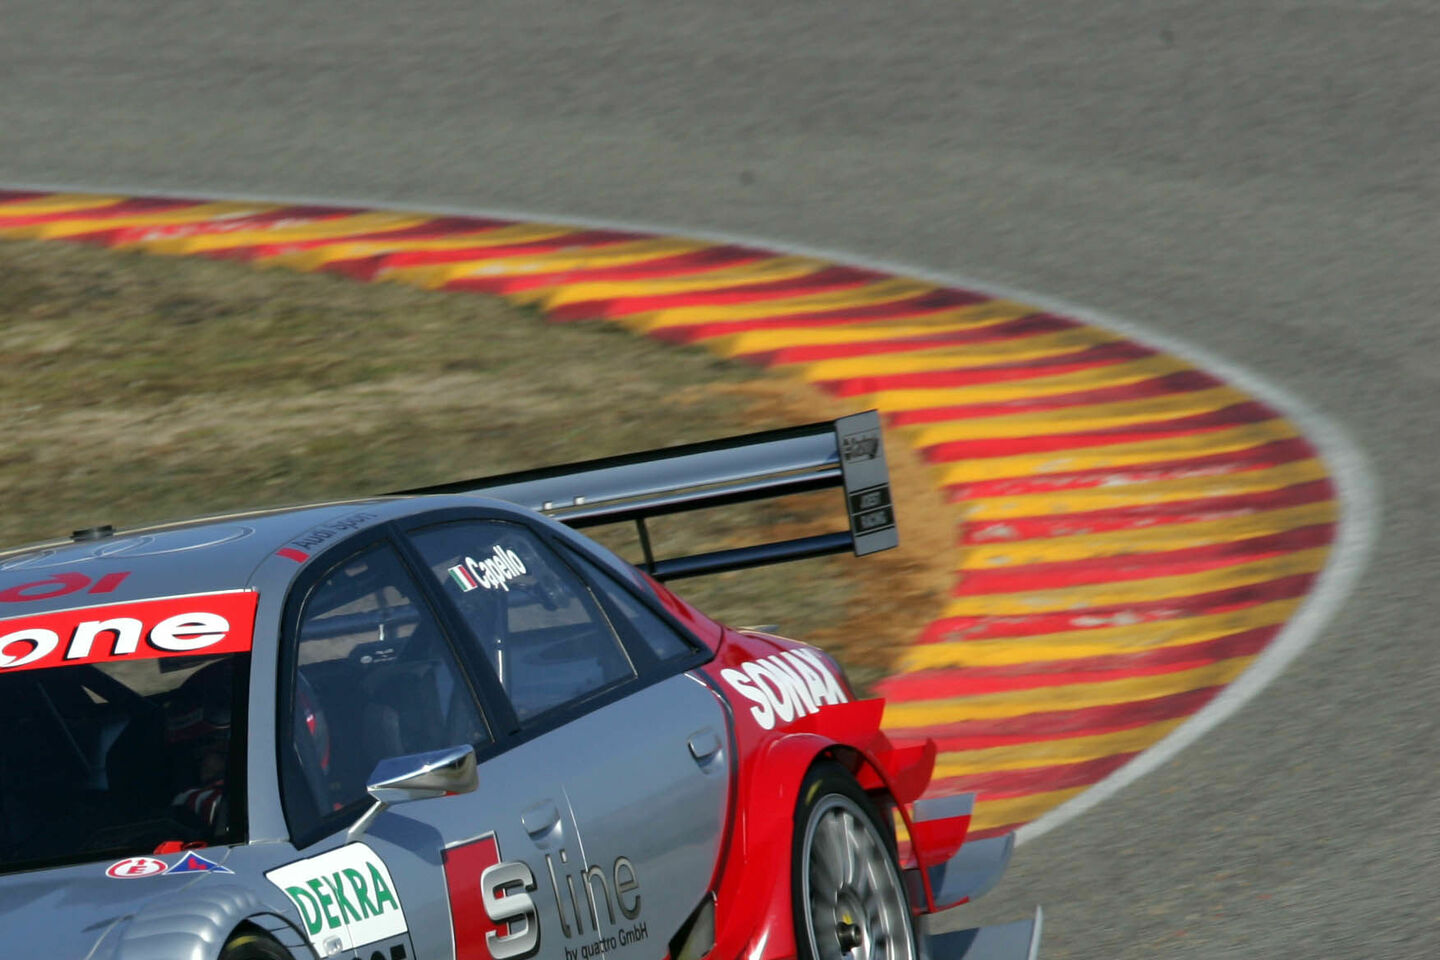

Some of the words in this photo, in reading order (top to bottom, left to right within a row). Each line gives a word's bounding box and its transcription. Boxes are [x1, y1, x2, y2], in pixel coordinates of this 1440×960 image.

[465, 544, 527, 592] Capello
[720, 648, 849, 730] SONAX
[285, 861, 399, 935] DEKRA
[545, 848, 642, 939] line
[581, 936, 618, 960] quattro
[618, 922, 649, 946] GmbH
